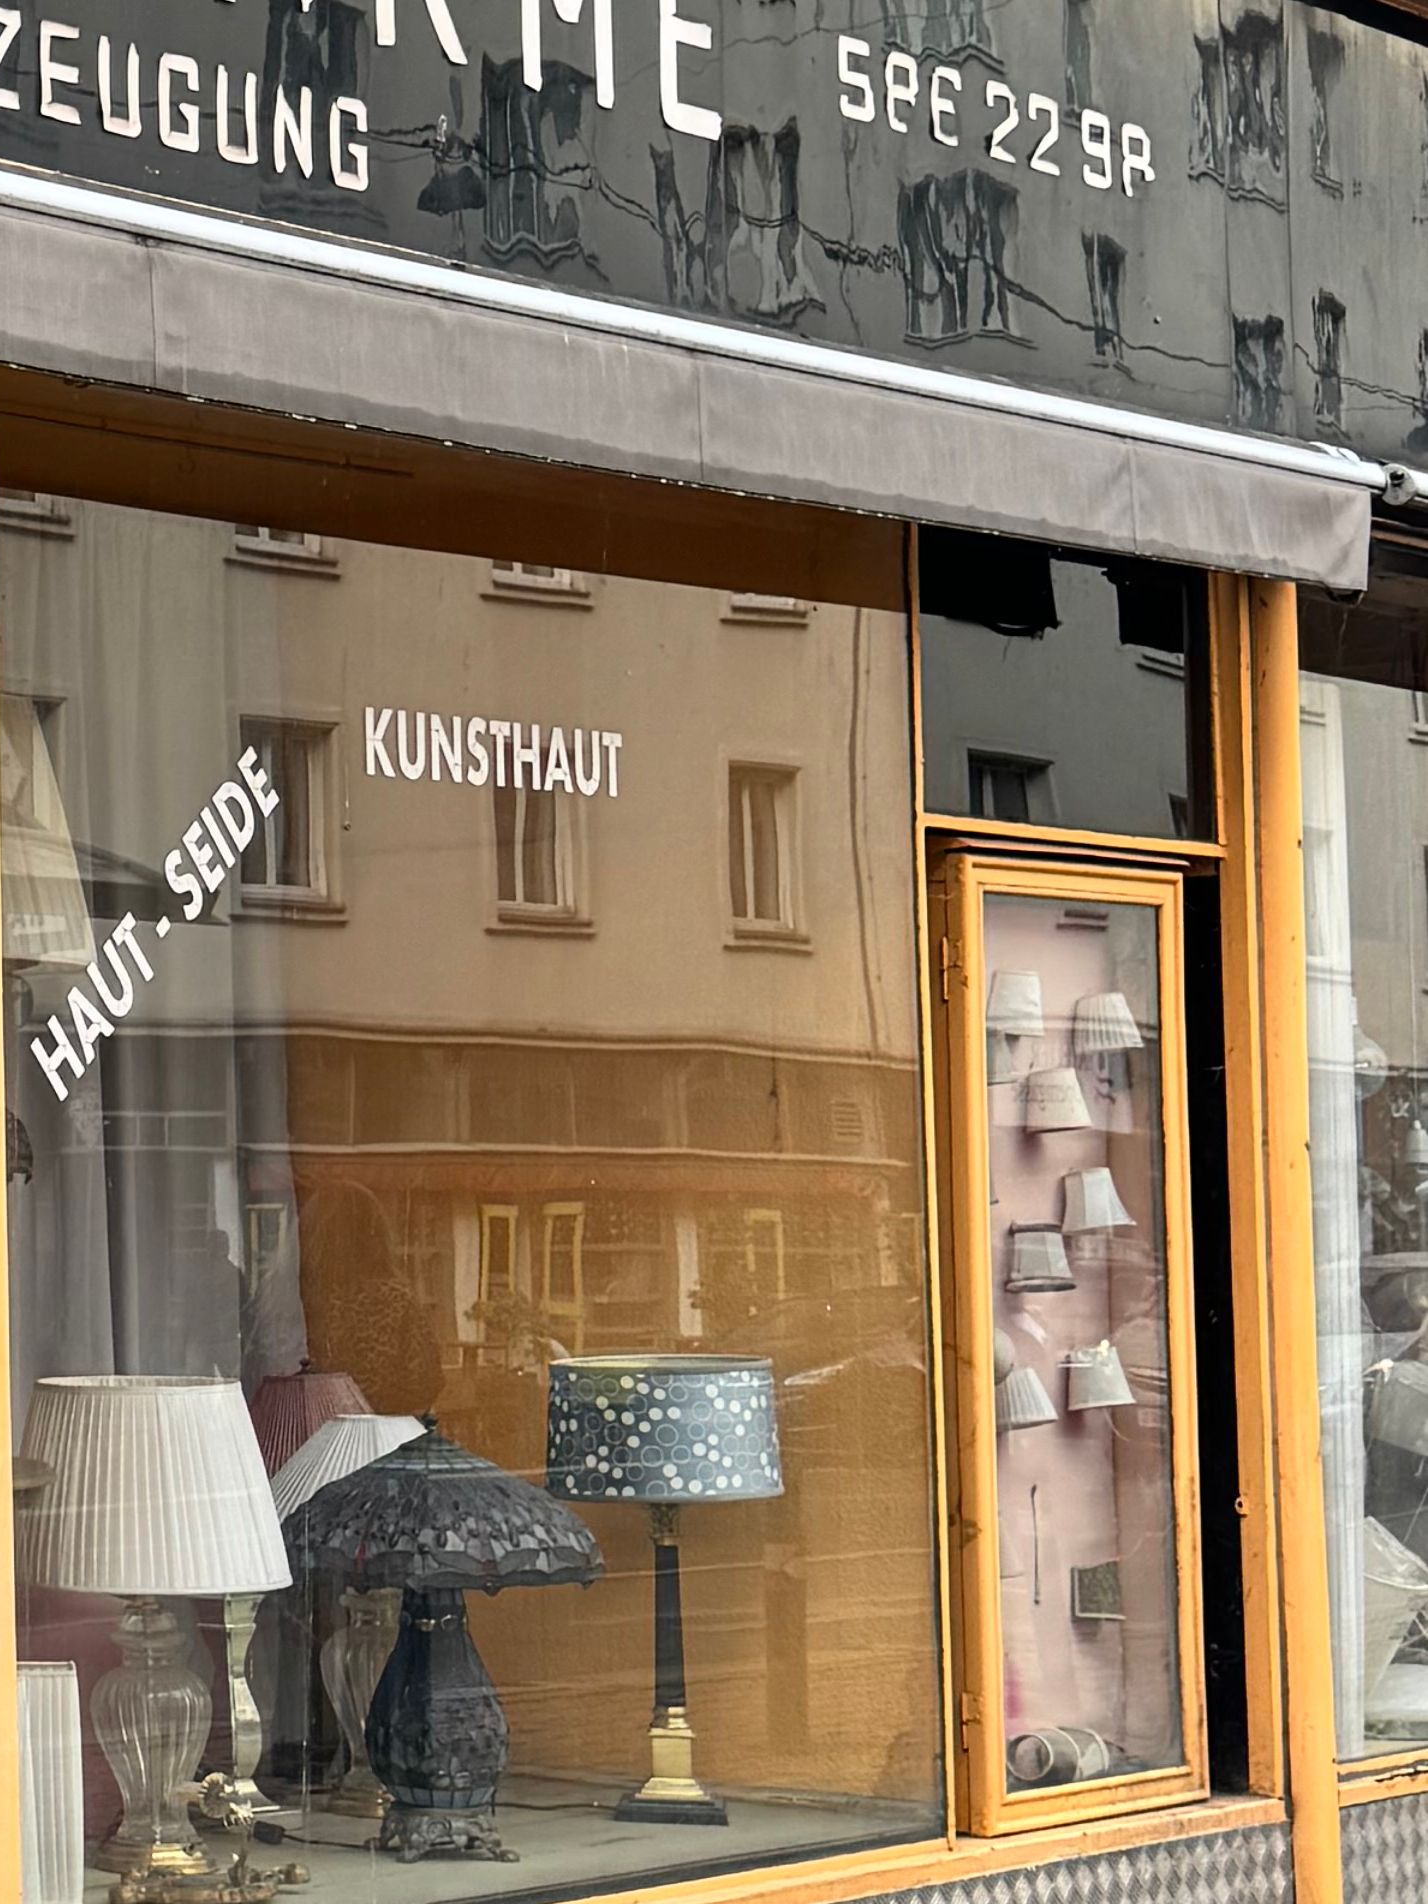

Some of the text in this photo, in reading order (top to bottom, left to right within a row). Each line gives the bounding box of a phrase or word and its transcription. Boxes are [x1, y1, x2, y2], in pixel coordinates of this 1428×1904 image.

[985, 79, 1061, 176] 22
[364, 705, 624, 799] KUNSTHAUT
[29, 910, 155, 1103] HAUT
[163, 745, 281, 921] SEIDE
